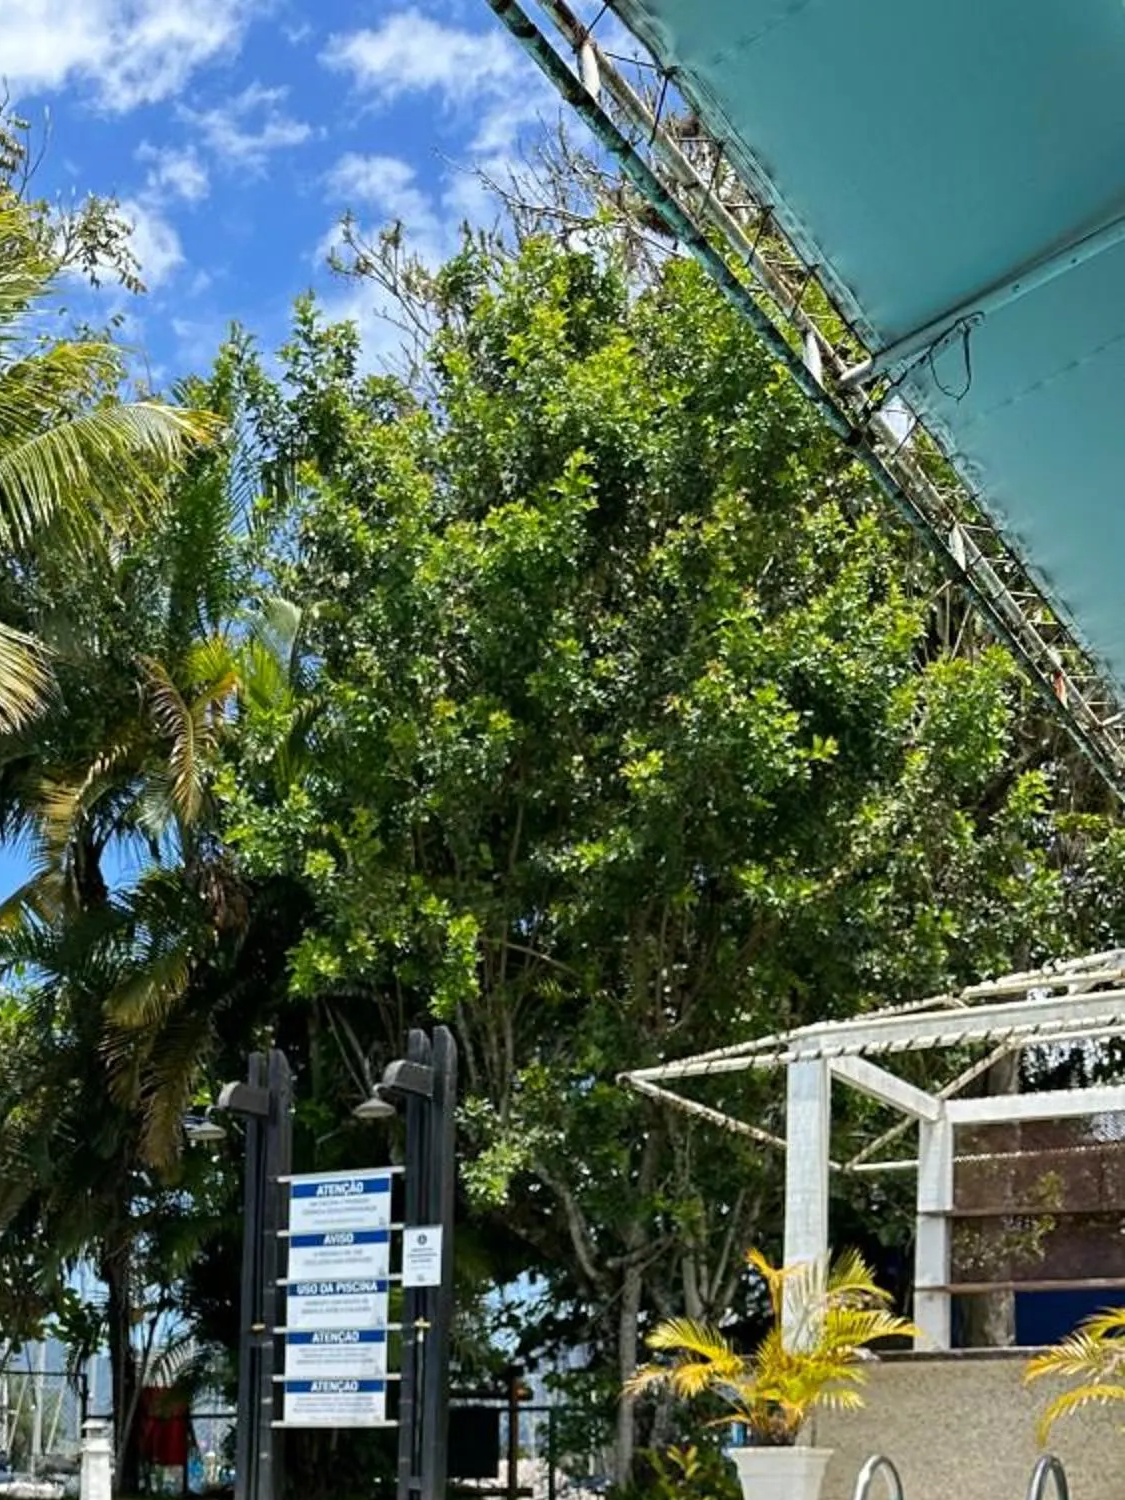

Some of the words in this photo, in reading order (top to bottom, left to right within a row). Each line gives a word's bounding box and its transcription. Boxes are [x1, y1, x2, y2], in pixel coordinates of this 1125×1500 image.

[316, 1180, 364, 1197] ATENÇÃO
[323, 1232, 354, 1245] AVISO
[297, 1283, 317, 1295] USO
[321, 1282, 333, 1294] DA
[337, 1281, 377, 1293] PISCINA
